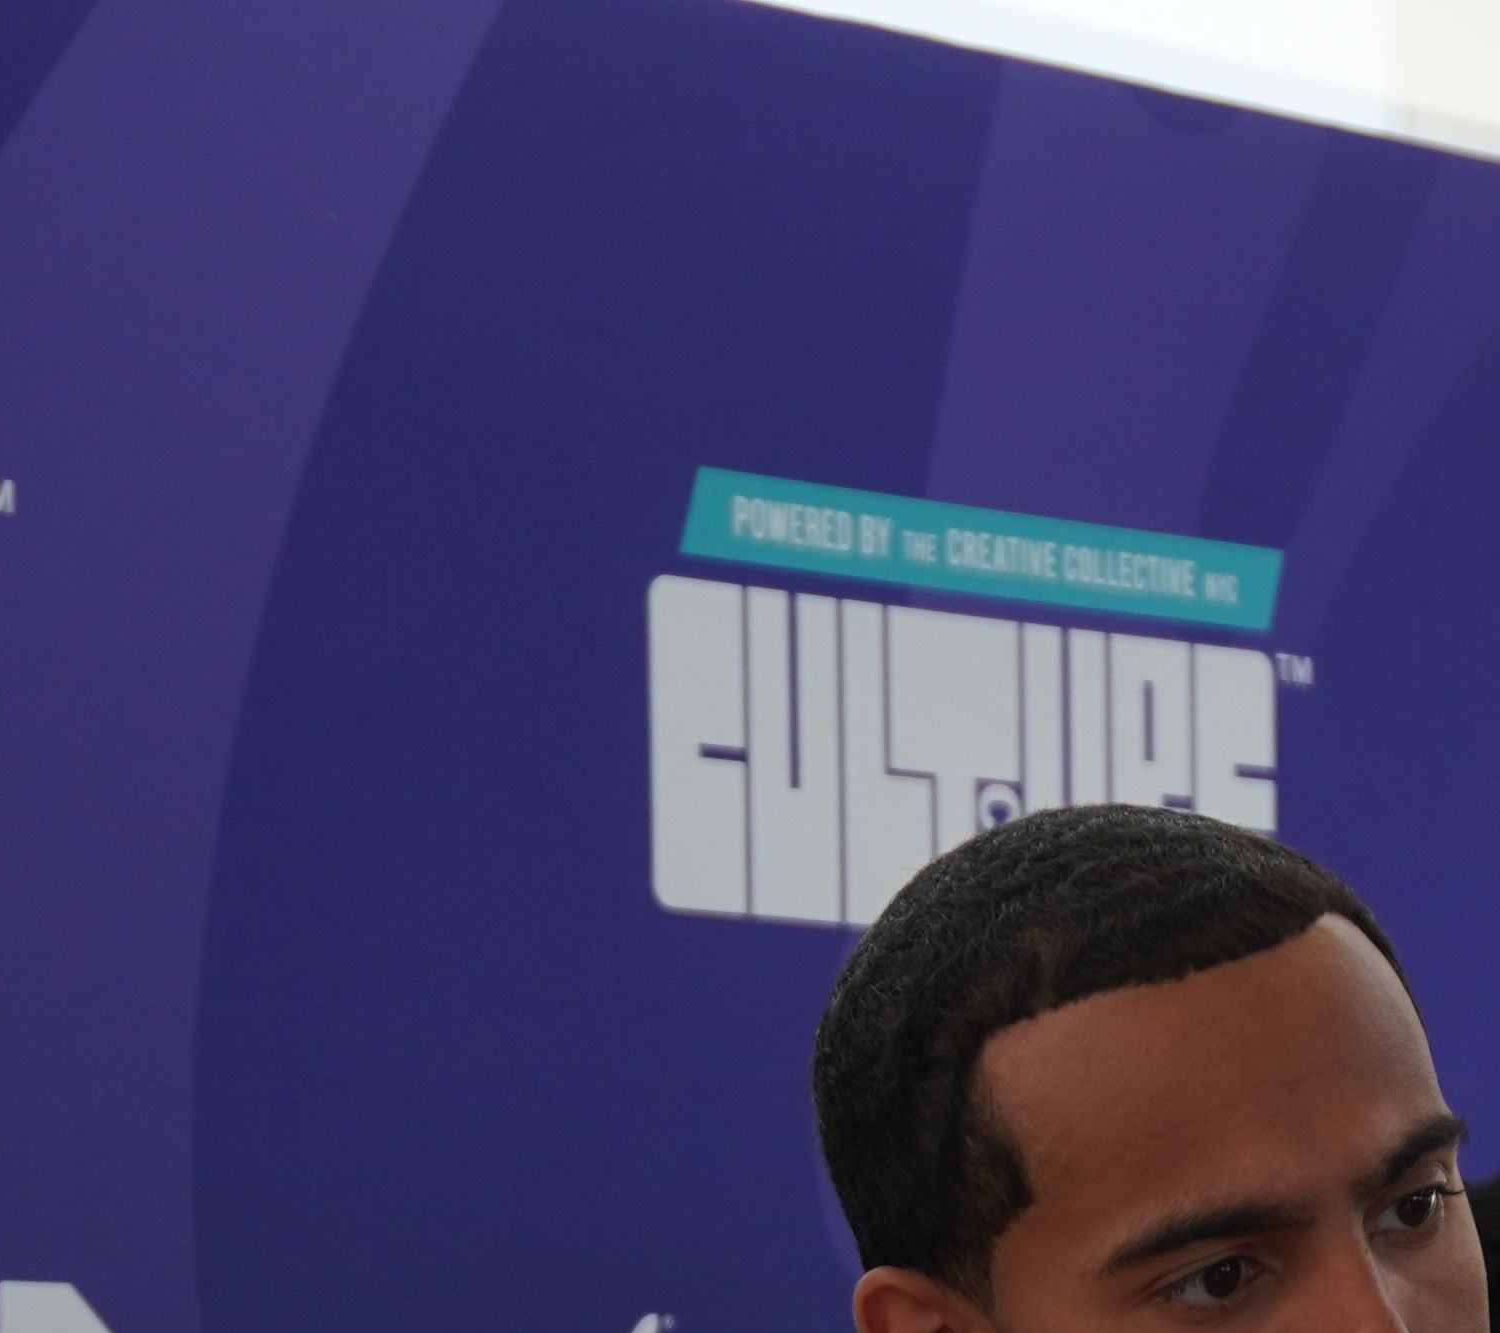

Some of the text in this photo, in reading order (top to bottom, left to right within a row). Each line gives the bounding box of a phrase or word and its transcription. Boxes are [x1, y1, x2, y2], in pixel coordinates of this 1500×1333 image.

[731, 495, 854, 553] POWERED
[858, 513, 893, 557] BY
[902, 529, 937, 562] THE
[945, 528, 1059, 579] CREATIVE
[1063, 543, 1196, 598] COLLECTIVE
